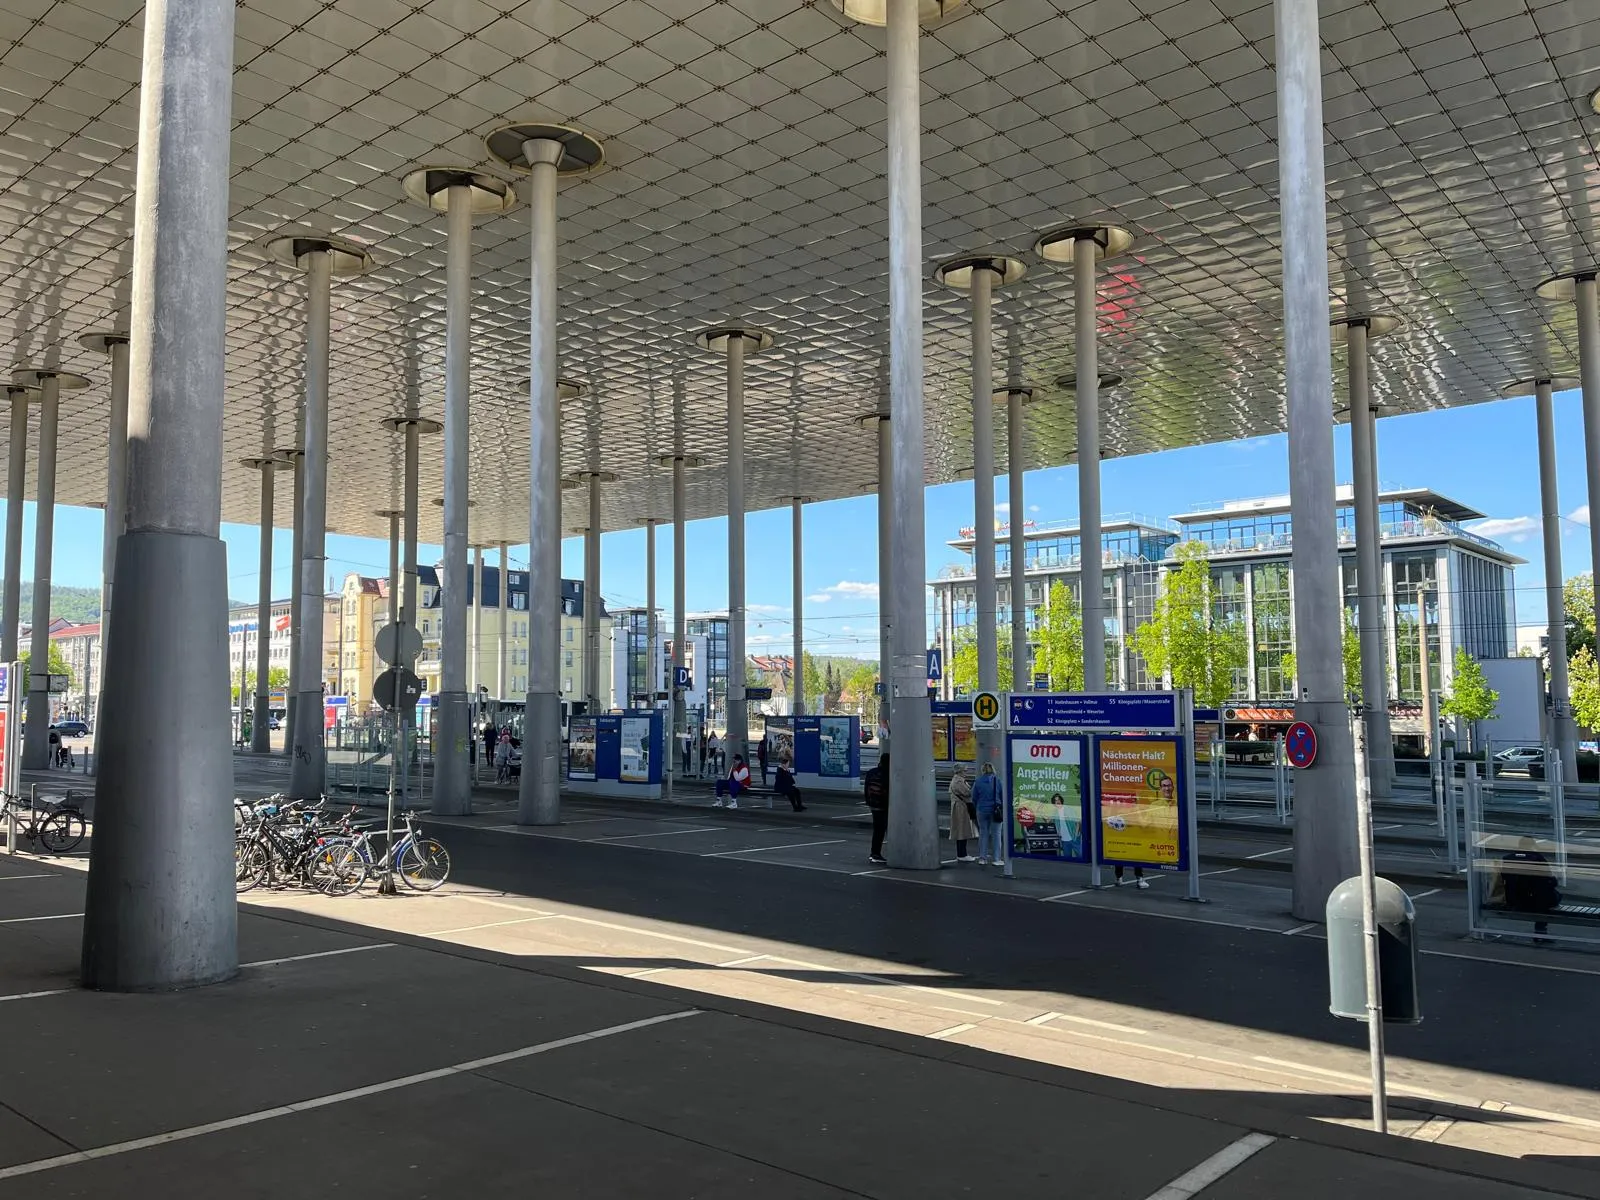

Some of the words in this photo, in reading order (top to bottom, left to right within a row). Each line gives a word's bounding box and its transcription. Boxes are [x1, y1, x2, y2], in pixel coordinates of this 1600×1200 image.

[929, 654, 940, 676] A
[679, 668, 688, 683] D
[421, 680, 426, 689] E
[1013, 714, 1020, 724] A
[1030, 744, 1061, 758] OTTO
[1102, 750, 1140, 760] Nächster
[1142, 751, 1166, 760] Halt?
[1103, 762, 1147, 771] Millionen-
[1016, 766, 1070, 781] Angrillen
[1103, 773, 1143, 783] Chancen!
[1038, 782, 1066, 792] Kohle
